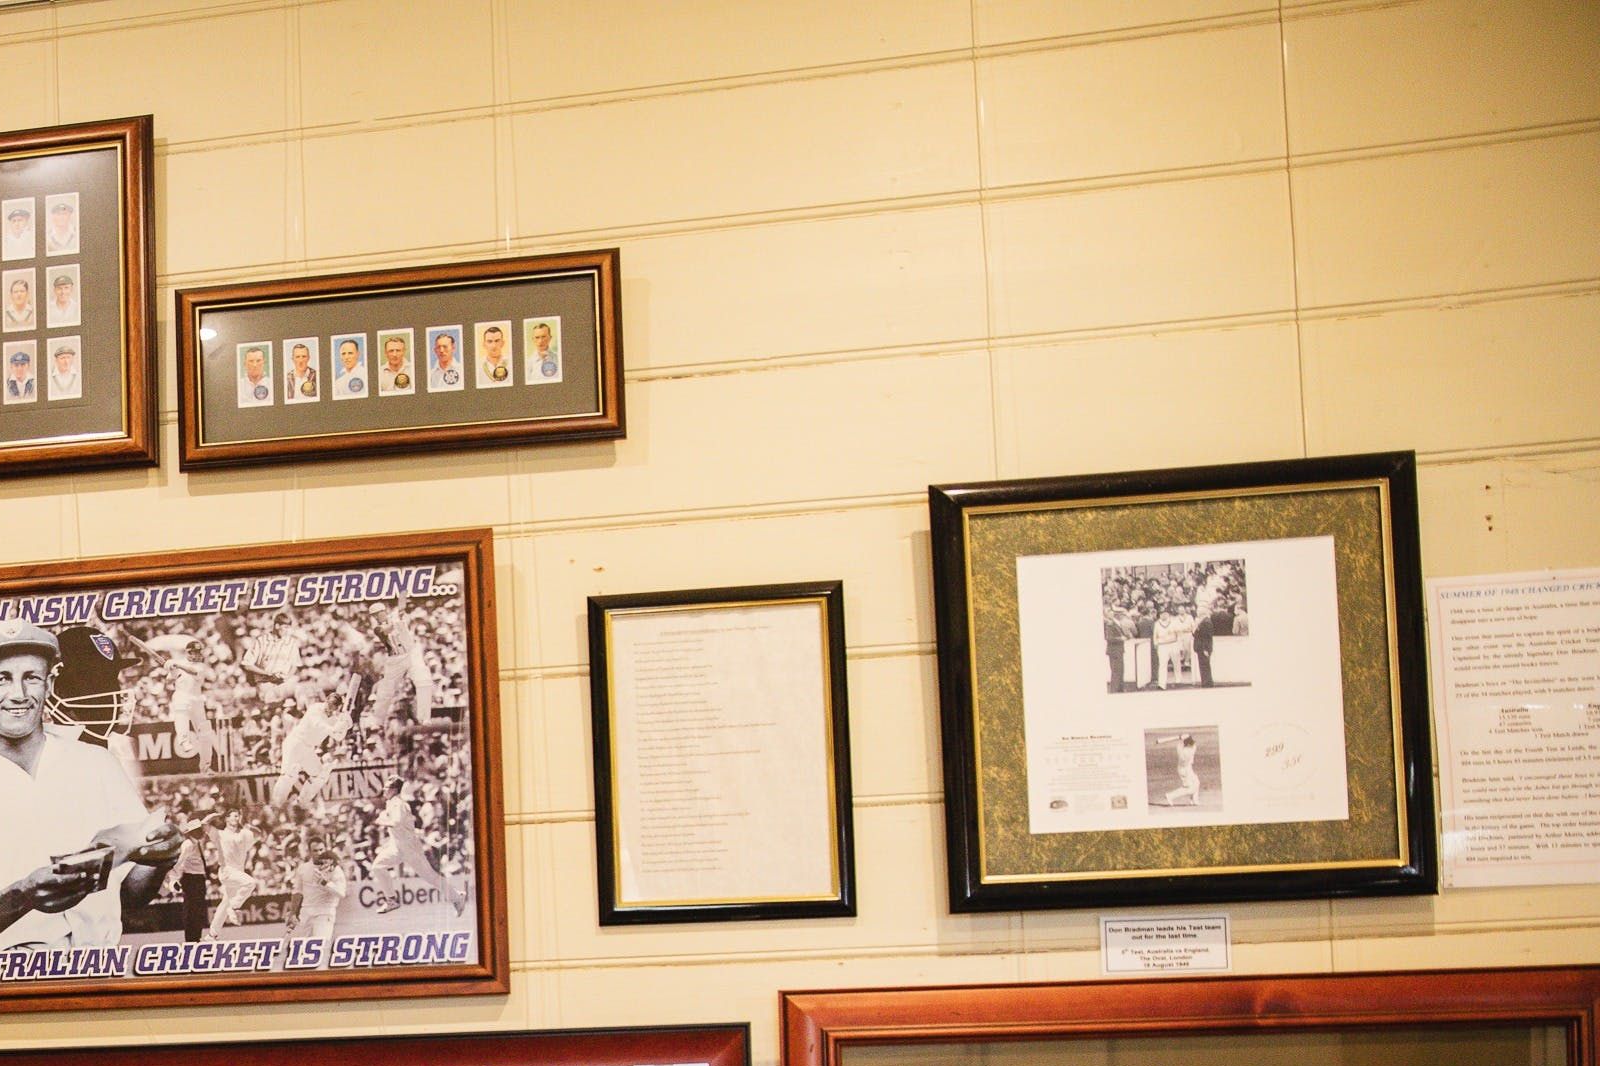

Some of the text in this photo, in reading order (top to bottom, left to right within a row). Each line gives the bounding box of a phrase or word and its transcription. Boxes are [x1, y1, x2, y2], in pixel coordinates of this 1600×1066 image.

[19, 594, 97, 625] NSW
[104, 582, 246, 619] CRICKET
[252, 579, 288, 607] IS
[297, 568, 457, 604] STRONG...
[1440, 590, 1482, 600] SUMMER
[1484, 589, 1496, 597] OF
[1521, 584, 1570, 595] CHANGED
[137, 940, 281, 973] CRICKET
[287, 938, 324, 966] IS
[332, 932, 470, 965] STRONG
